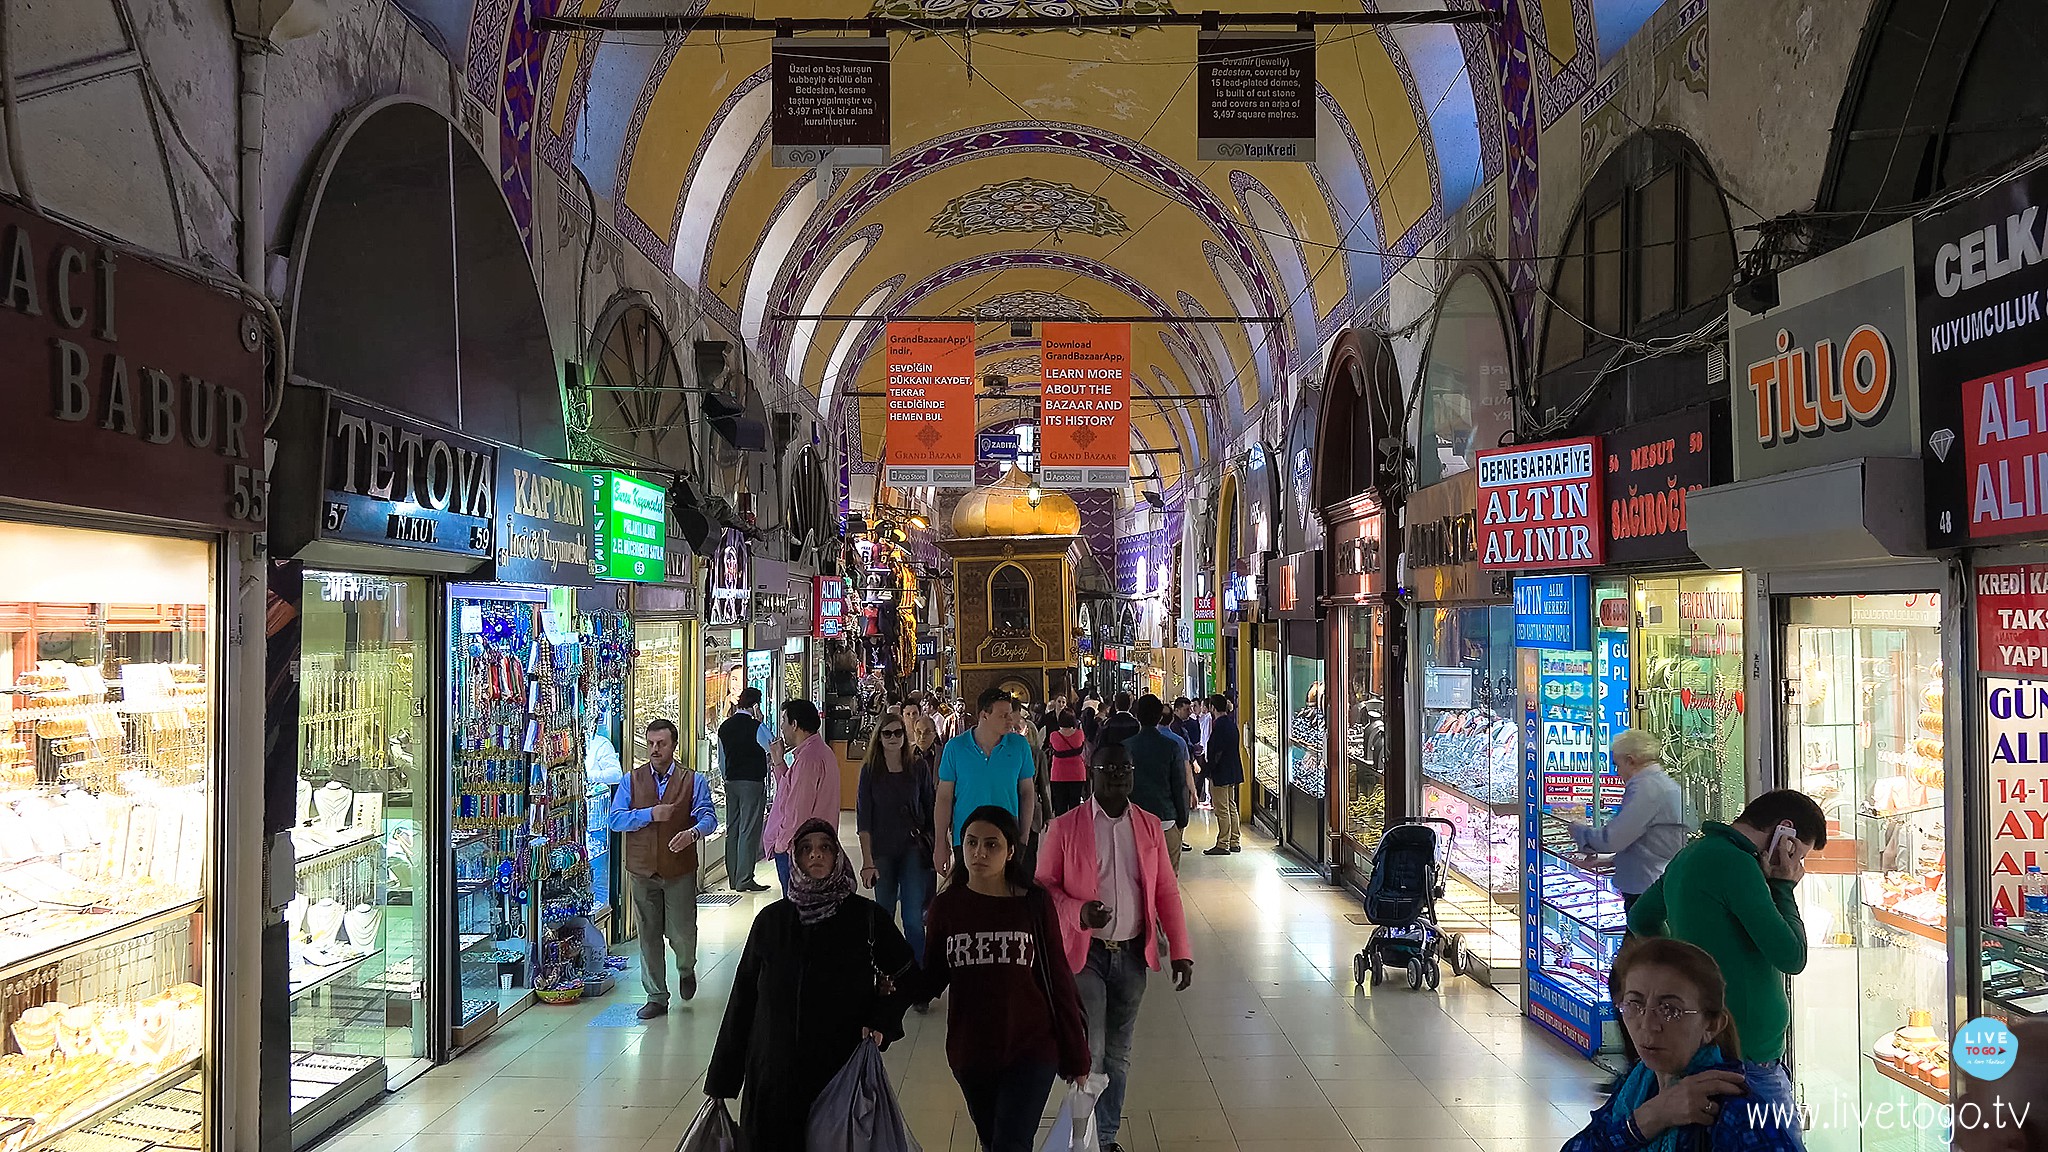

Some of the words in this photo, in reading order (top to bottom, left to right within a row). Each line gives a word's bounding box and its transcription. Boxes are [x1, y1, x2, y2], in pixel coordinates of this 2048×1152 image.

[789, 63, 811, 73] Üzeri
[825, 65, 841, 74] beş
[843, 65, 872, 74] kurşun
[1211, 68, 1253, 78] Bedesten,
[1254, 68, 1287, 77] covered
[1289, 68, 1300, 78] by
[788, 75, 826, 85] kubbeyle
[828, 75, 853, 83] örtülü
[855, 75, 873, 83] olan
[1211, 79, 1221, 87] 15
[1222, 79, 1268, 88] lead-plated
[1270, 79, 1301, 88] domes,
[795, 86, 837, 95] Bedesten,
[839, 86, 866, 94] kesme
[1216, 89, 1224, 97] is
[1226, 89, 1245, 97] built
[1246, 89, 1255, 97] of
[1256, 89, 1270, 97] cut
[1272, 89, 1295, 97] stone
[789, 97, 815, 106] taştan
[816, 97, 861, 107] yapılmıştır
[1211, 100, 1227, 108] and
[1292, 100, 1301, 108] of
[788, 107, 810, 116] 3.497
[837, 107, 849, 115] bir
[850, 107, 873, 115] alana
[1213, 110, 1235, 120] 3,497
[1237, 111, 1266, 120] square
[1268, 110, 1299, 119] metres.
[804, 117, 857, 127] kurulmuştur.
[1244, 143, 1296, 158] YapıKredi
[1934, 205, 2048, 298] CELK
[1931, 290, 2041, 355] KUYUMCULUK
[1046, 341, 1092, 349] Download
[1046, 352, 1125, 363] GrandBazaarApp,
[890, 362, 933, 373] SEVDİĞİN
[1045, 369, 1084, 379] LEARN
[1087, 369, 1123, 379] MORE
[890, 375, 932, 385] DÜKKANI
[934, 377, 973, 386] KAYDET,
[1748, 324, 1891, 443] TİLLO
[890, 389, 926, 397] TEKRAR
[1045, 385, 1087, 395] ABOUT
[1089, 385, 1112, 395] THE
[53, 338, 250, 459] BABUR
[890, 399, 945, 409] GELDİĞİNDE
[1045, 401, 1093, 410] BAZAAR
[1096, 401, 1123, 410] AND
[890, 413, 923, 421] HEMEN
[925, 413, 943, 421] BUL
[1045, 416, 1062, 426] ITS
[1065, 416, 1115, 426] HISTORY
[991, 441, 1017, 449] ZABITA
[895, 451, 927, 460] GRAND
[929, 451, 962, 460] BAZAAR
[1050, 451, 1082, 460] GRAND
[1084, 451, 1117, 460] BAZAAR
[1630, 438, 1675, 472] MESUT
[337, 409, 493, 519] TETOVA
[1481, 458, 1519, 482] DEFNE
[1520, 447, 1590, 479] SARRAFİYE
[230, 465, 267, 522] 55
[513, 468, 584, 527] KAPTAN
[1483, 482, 1589, 525] ALTIN
[1611, 475, 1703, 541] SAĞIROĞL
[327, 502, 349, 533] 57
[1939, 510, 1952, 533] 48
[396, 514, 439, 544] N.KUY.
[475, 525, 490, 550] 59
[1483, 525, 1592, 564] ALINIR
[1978, 567, 2026, 595] KREDİ
[821, 580, 842, 599] ALTIN
[1515, 585, 1542, 615] ALTIN
[1548, 583, 1564, 597] ALIM
[821, 601, 842, 616] ALINIR
[1997, 609, 2048, 630] TAK
[1197, 622, 1214, 635] ALTIN
[1195, 638, 1215, 650] ALINIR
